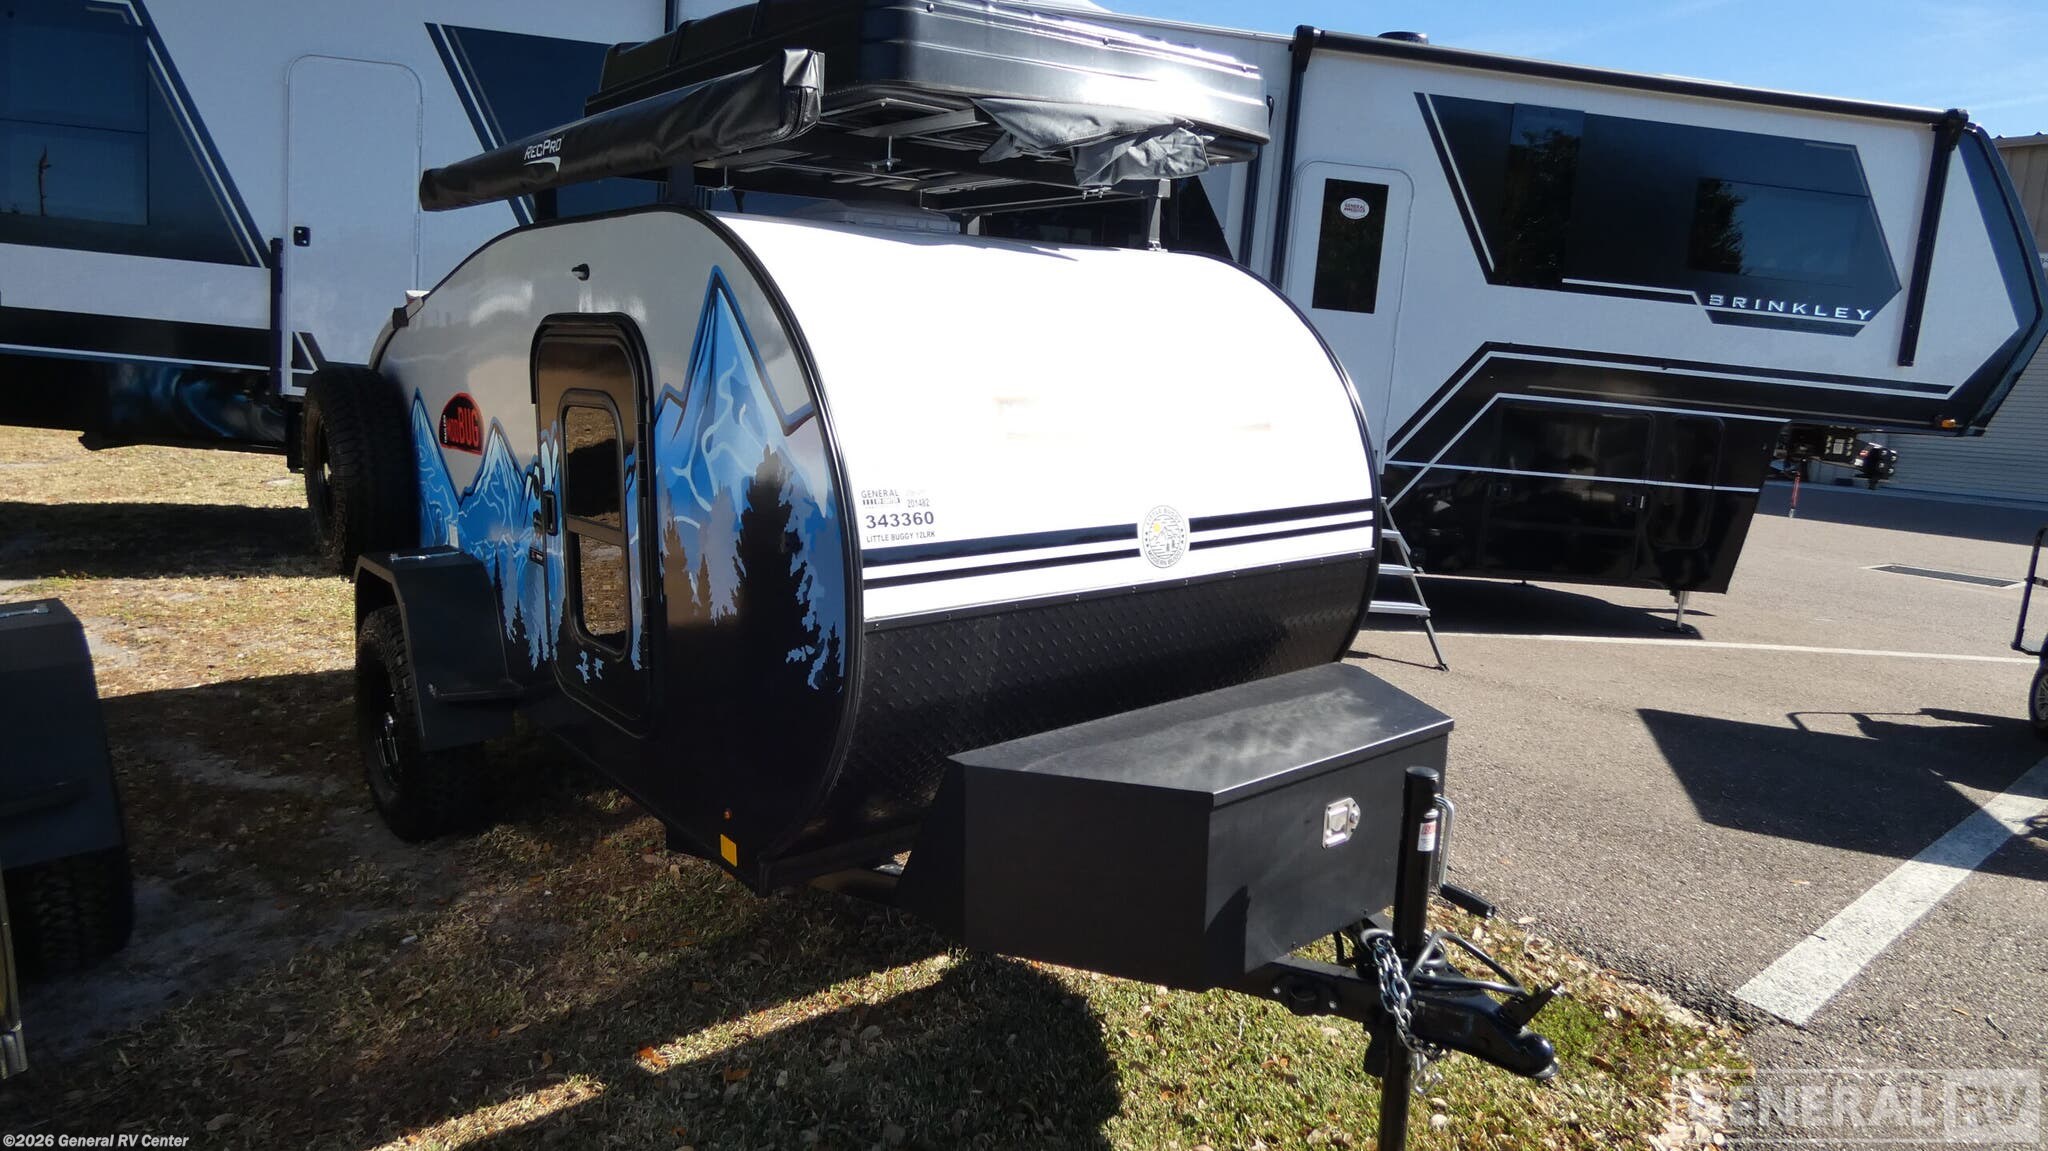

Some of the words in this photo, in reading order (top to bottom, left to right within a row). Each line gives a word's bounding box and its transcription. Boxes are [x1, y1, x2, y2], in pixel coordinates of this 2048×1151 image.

[1709, 294, 1872, 320] BRINKLEY
[861, 489, 900, 499] GENERAL
[865, 511, 935, 529] 343360
[866, 534, 889, 543] LITTLE
[891, 532, 914, 541] BUGGY
